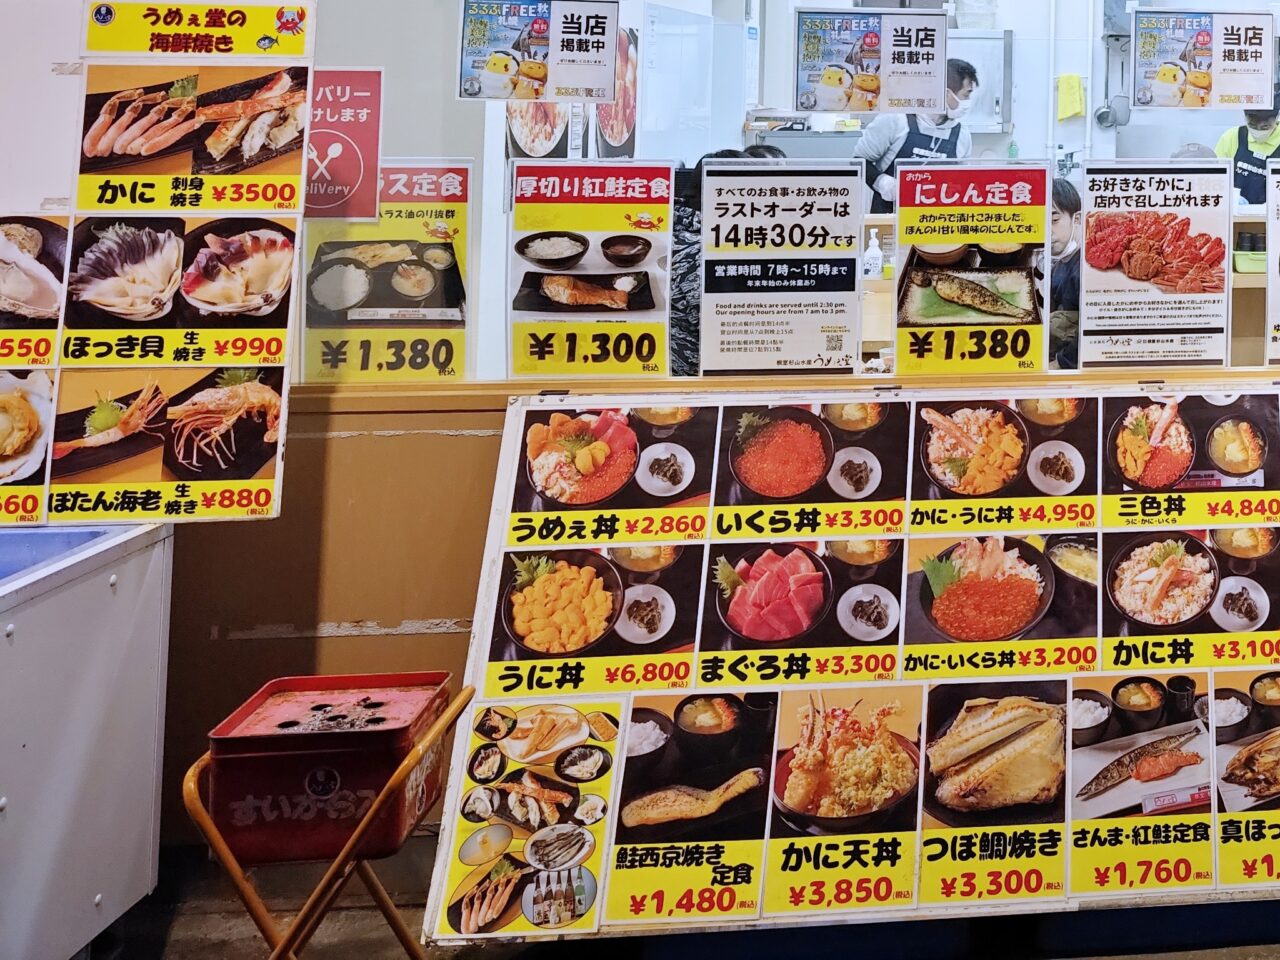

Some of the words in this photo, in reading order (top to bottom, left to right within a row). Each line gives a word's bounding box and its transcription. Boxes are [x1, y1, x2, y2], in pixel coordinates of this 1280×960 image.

[561, 13, 608, 36] 当店
[1222, 26, 1264, 47] 当店
[149, 32, 234, 53] 海鮮焼き
[560, 38, 605, 53] 掲載中
[892, 26, 936, 48] 当店
[891, 50, 935, 65] 掲載中
[1222, 49, 1263, 63] 掲載中
[515, 175, 670, 199] 厚切り紅鮭定食
[905, 172, 932, 181] おから
[1088, 177, 1192, 192] お好きな「かに」
[97, 179, 156, 205] かに
[171, 176, 205, 191] 刺身
[212, 183, 296, 203] ¥3500
[170, 192, 203, 207] 焼き
[715, 187, 850, 198] すべてのお食事・お飲み物の
[914, 181, 1032, 205] にしん定食
[1094, 194, 1223, 209] 店内で召し上がれます
[714, 201, 850, 218] ラストオーダーは
[918, 213, 1025, 223] おからで漬けこみました。
[710, 223, 857, 249] 14時30分です
[905, 224, 1038, 235] ほんのり甘い風味のにしんです。
[714, 264, 762, 277] 営業時間
[64, 335, 165, 359] ほっき貝
[184, 331, 200, 345] 生
[214, 337, 283, 358] ¥990
[173, 347, 206, 362] 焼き
[321, 338, 454, 372] ¥1,380
[528, 332, 657, 364] ¥1,300
[908, 328, 1031, 361] ¥1,380
[1018, 360, 1035, 369] 税込
[164, 499, 198, 515] 焼き
[175, 483, 191, 498] 生
[201, 488, 272, 508] ¥880
[1118, 494, 1187, 518] 三色丼
[624, 515, 706, 536] ¥2,860
[716, 507, 822, 535] いくら丼
[824, 508, 904, 529] ¥3,300
[910, 505, 1015, 527] かに・うに丼
[1018, 503, 1096, 524] ¥4,950
[904, 649, 1016, 672] かに・いくら丼
[1018, 645, 1097, 668] ¥3,200
[1113, 638, 1194, 666] かに丼
[498, 661, 586, 692] うに丼
[604, 661, 690, 685] ¥6,800
[701, 652, 812, 682] まぐろ丼
[815, 653, 897, 676] ¥3,300
[922, 829, 1062, 862] つぼ鯛焼き
[1072, 822, 1211, 849] さんま・紅鮭定食
[616, 843, 725, 870] 鮭西京焼き
[781, 837, 902, 873] かに天丼
[710, 863, 755, 887] 定食
[940, 868, 1043, 900] ¥3,300
[1094, 858, 1192, 888] ¥1,760
[629, 887, 737, 917] ¥1,480
[789, 876, 893, 908] ¥3,850
